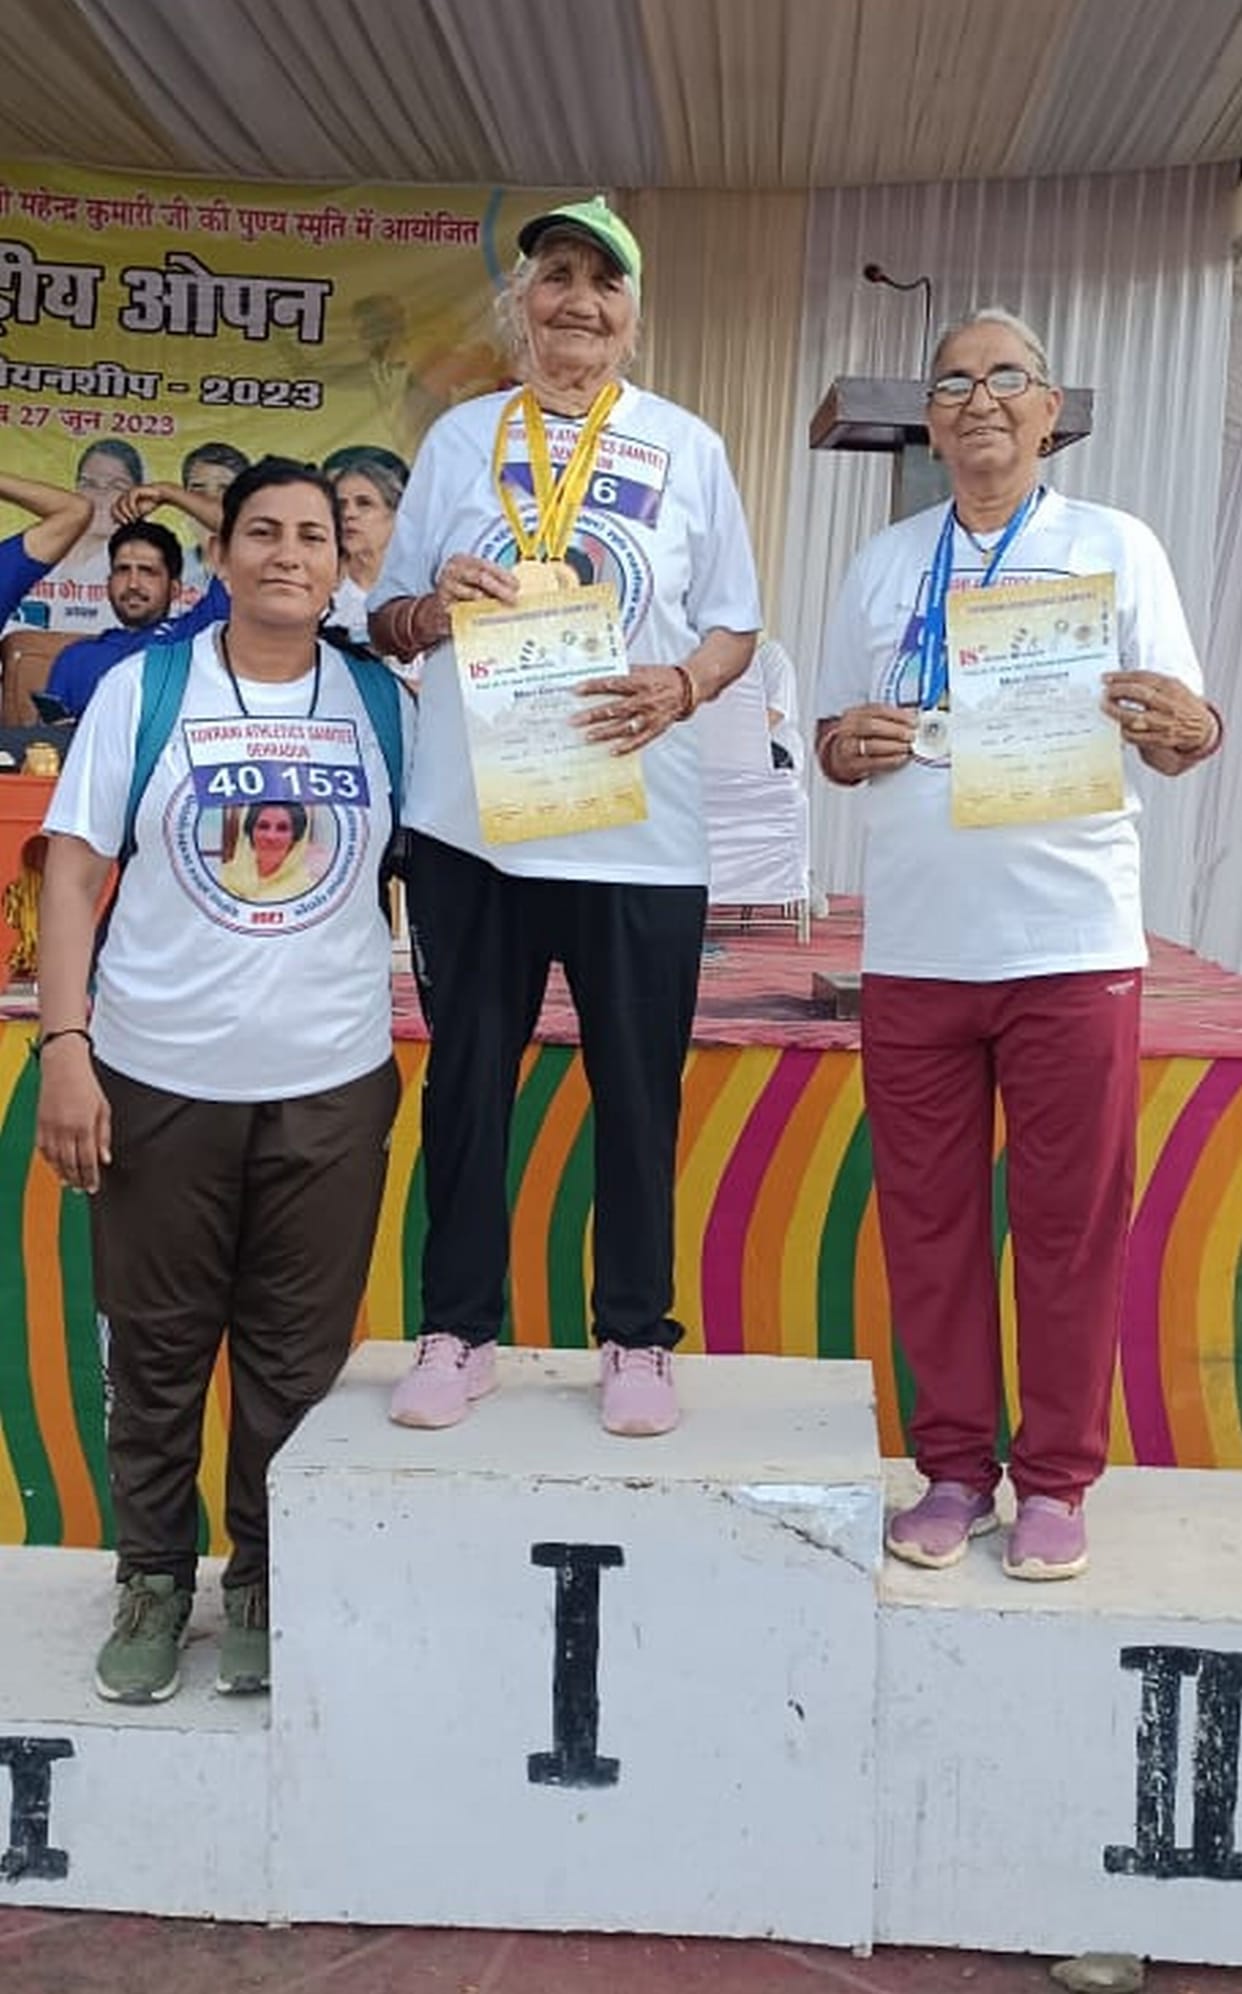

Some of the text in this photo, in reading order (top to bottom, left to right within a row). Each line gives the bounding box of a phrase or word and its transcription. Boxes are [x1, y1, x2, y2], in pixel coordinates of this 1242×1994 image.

[86, 192, 153, 230] कुमारी
[160, 195, 190, 231] जी
[199, 198, 230, 232] की
[238, 207, 287, 242] पुण्य
[295, 206, 347, 244] स्मृति
[354, 207, 374, 240] में
[381, 210, 480, 244] आयोजित
[120, 252, 333, 343] ओपन
[200, 374, 323, 410] 2023
[20, 405, 50, 427] 27
[57, 408, 103, 436] जून
[111, 412, 175, 437] 2023
[208, 766, 360, 798] 40 153
[528, 1540, 624, 1790] I
